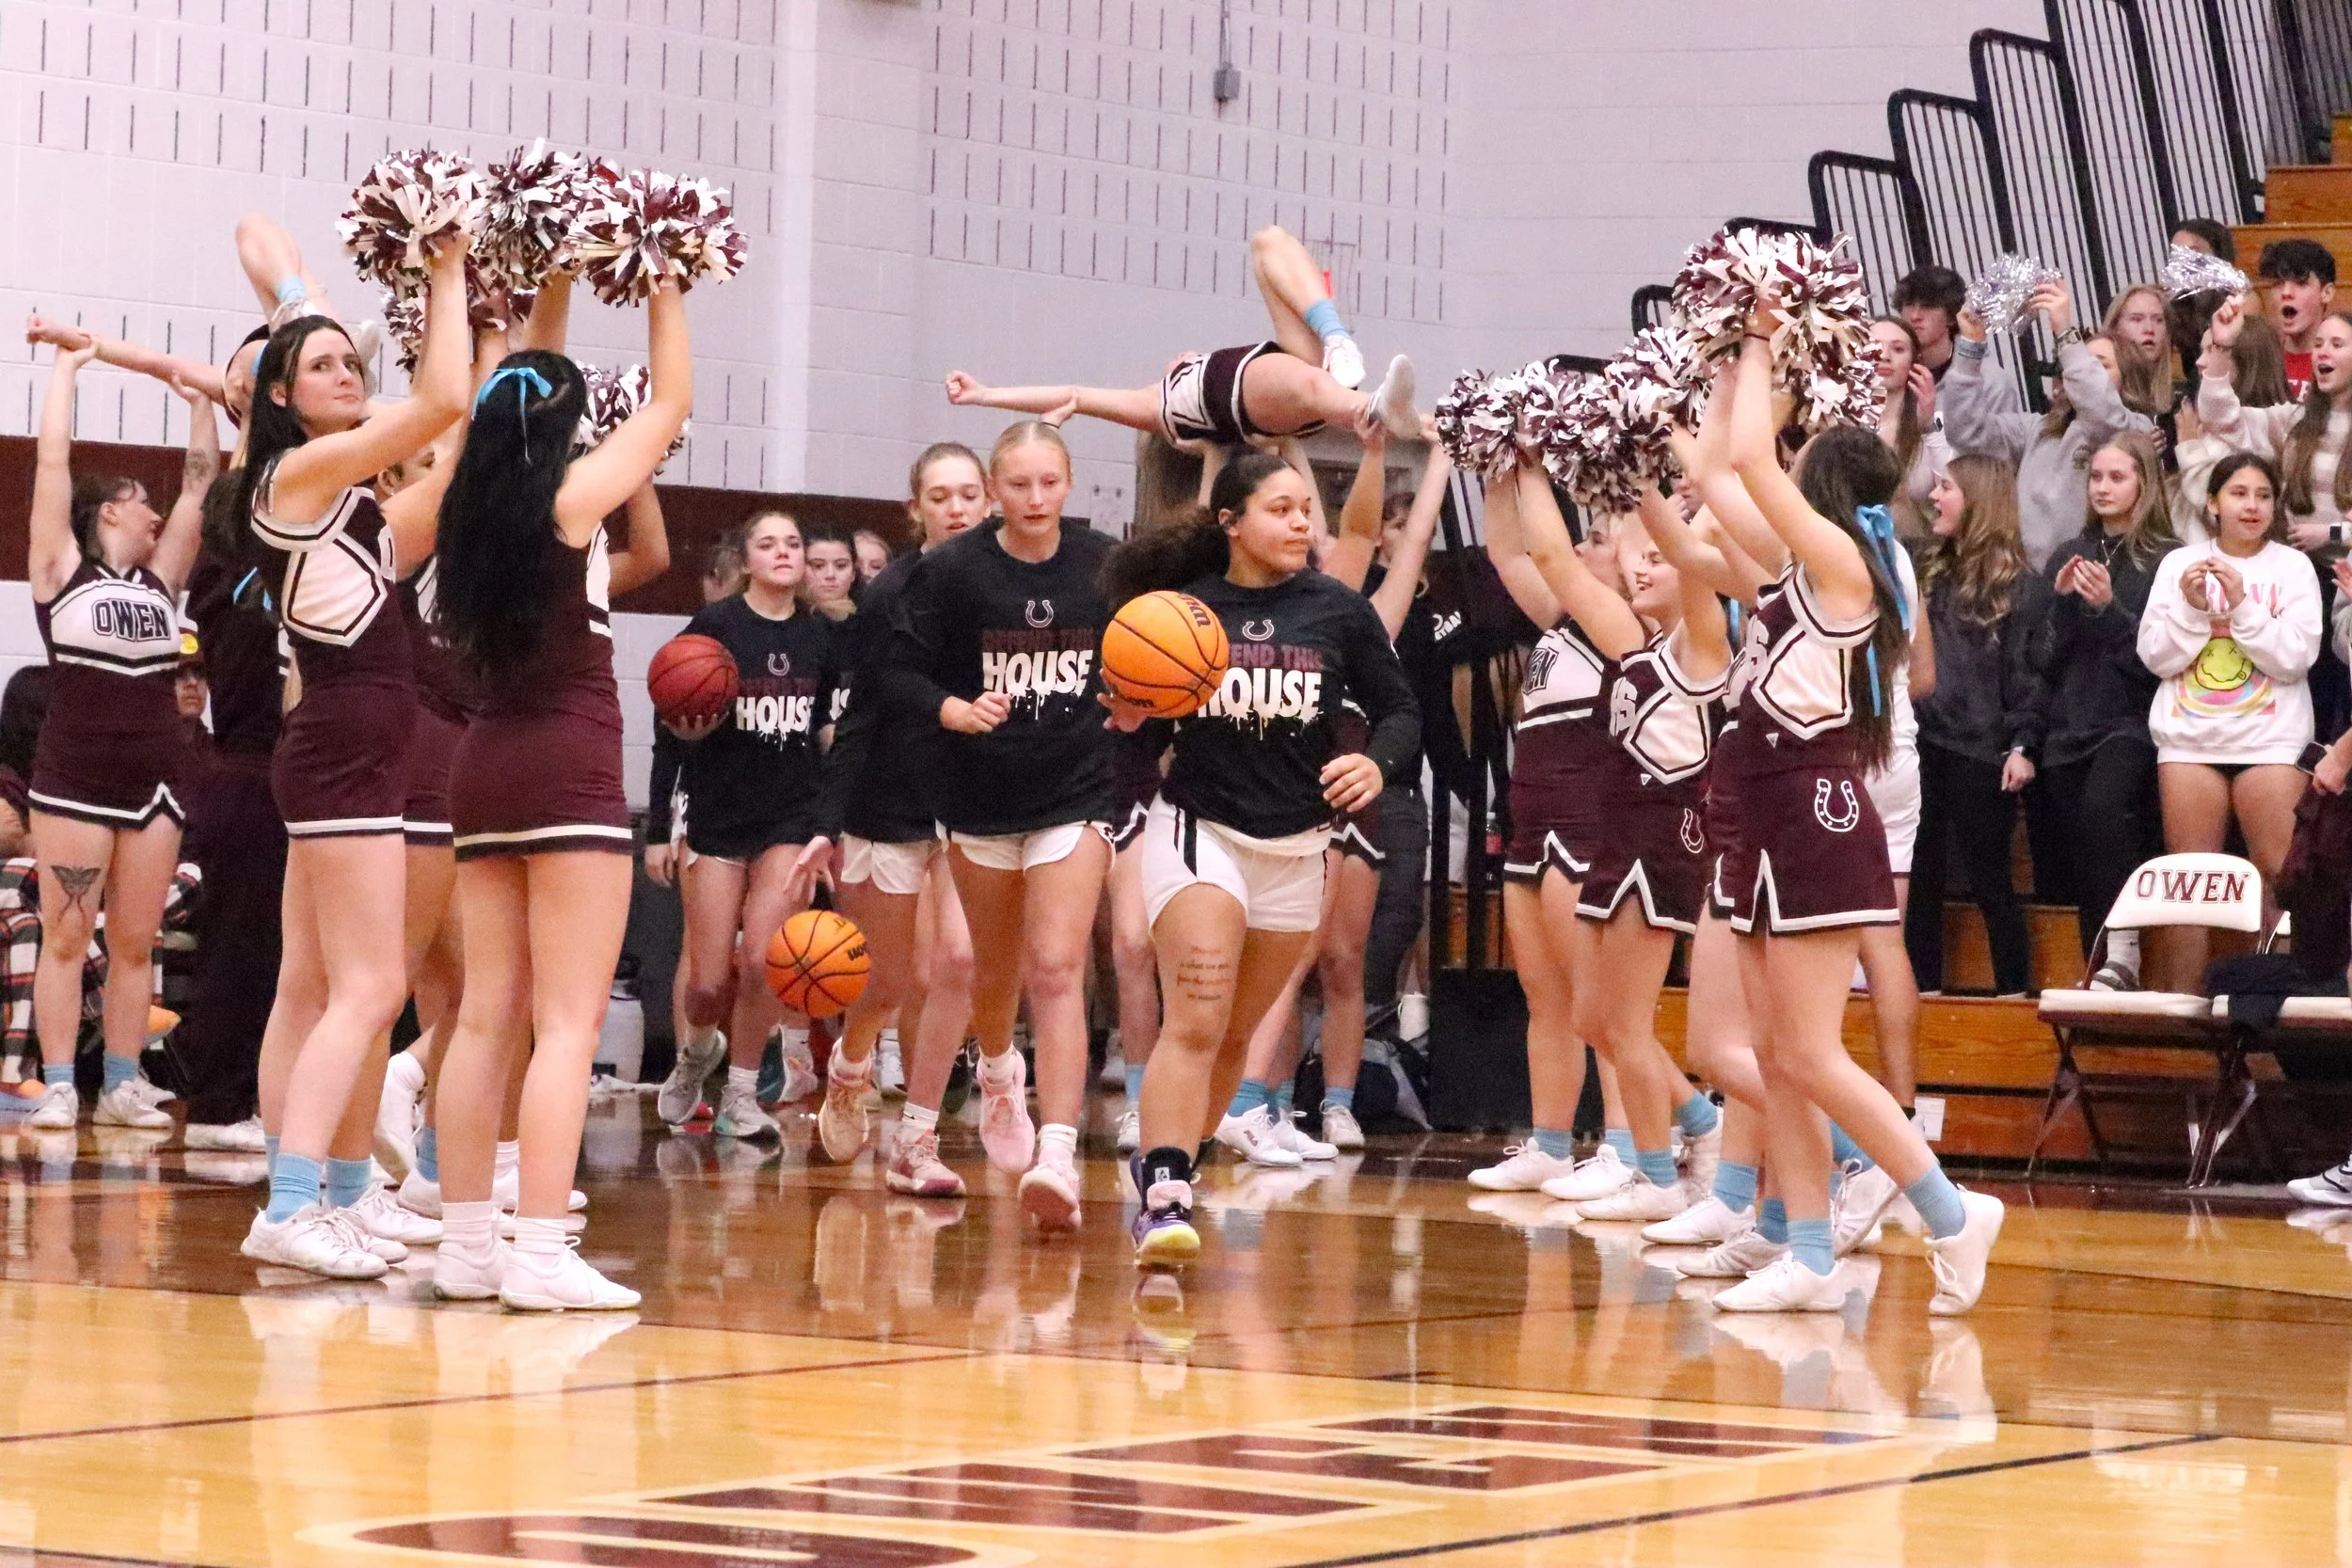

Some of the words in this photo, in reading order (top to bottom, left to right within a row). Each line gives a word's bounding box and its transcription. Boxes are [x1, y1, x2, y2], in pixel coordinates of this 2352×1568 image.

[91, 597, 171, 642] OWEN
[982, 649, 1093, 698] HOUSE
[1231, 643, 1276, 667] END
[2137, 868, 2251, 904] OWEN
[310, 1402, 1938, 1568] OWEN
